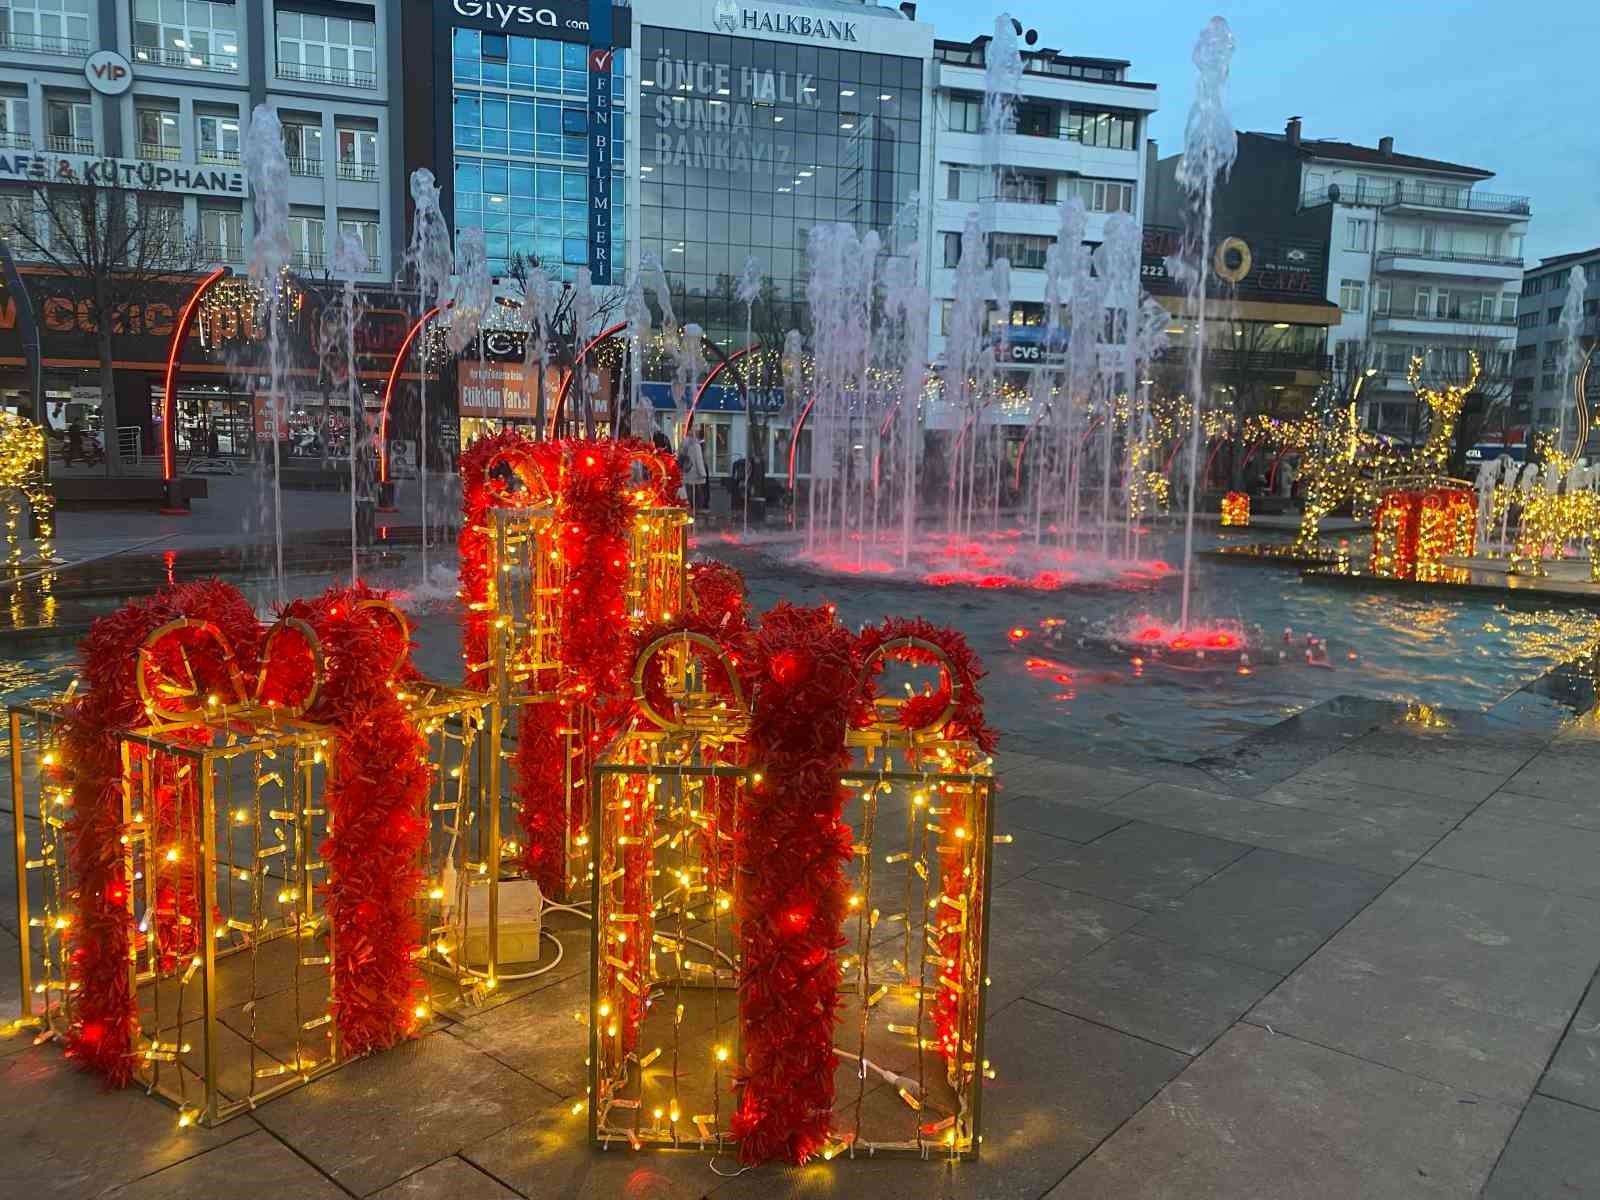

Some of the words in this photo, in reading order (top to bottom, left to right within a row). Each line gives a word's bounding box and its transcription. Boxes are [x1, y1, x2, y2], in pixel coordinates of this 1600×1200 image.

[742, 8, 857, 42] HALKBANK
[656, 48, 730, 94] ÖNCE
[596, 78, 607, 124] FEN
[656, 95, 750, 135] SONRA
[83, 159, 242, 191] KÜTÜPHANE
[656, 132, 792, 176] BANKAYIZ
[594, 135, 608, 276] BİLİMLERİ
[1012, 346, 1040, 359] CVS
